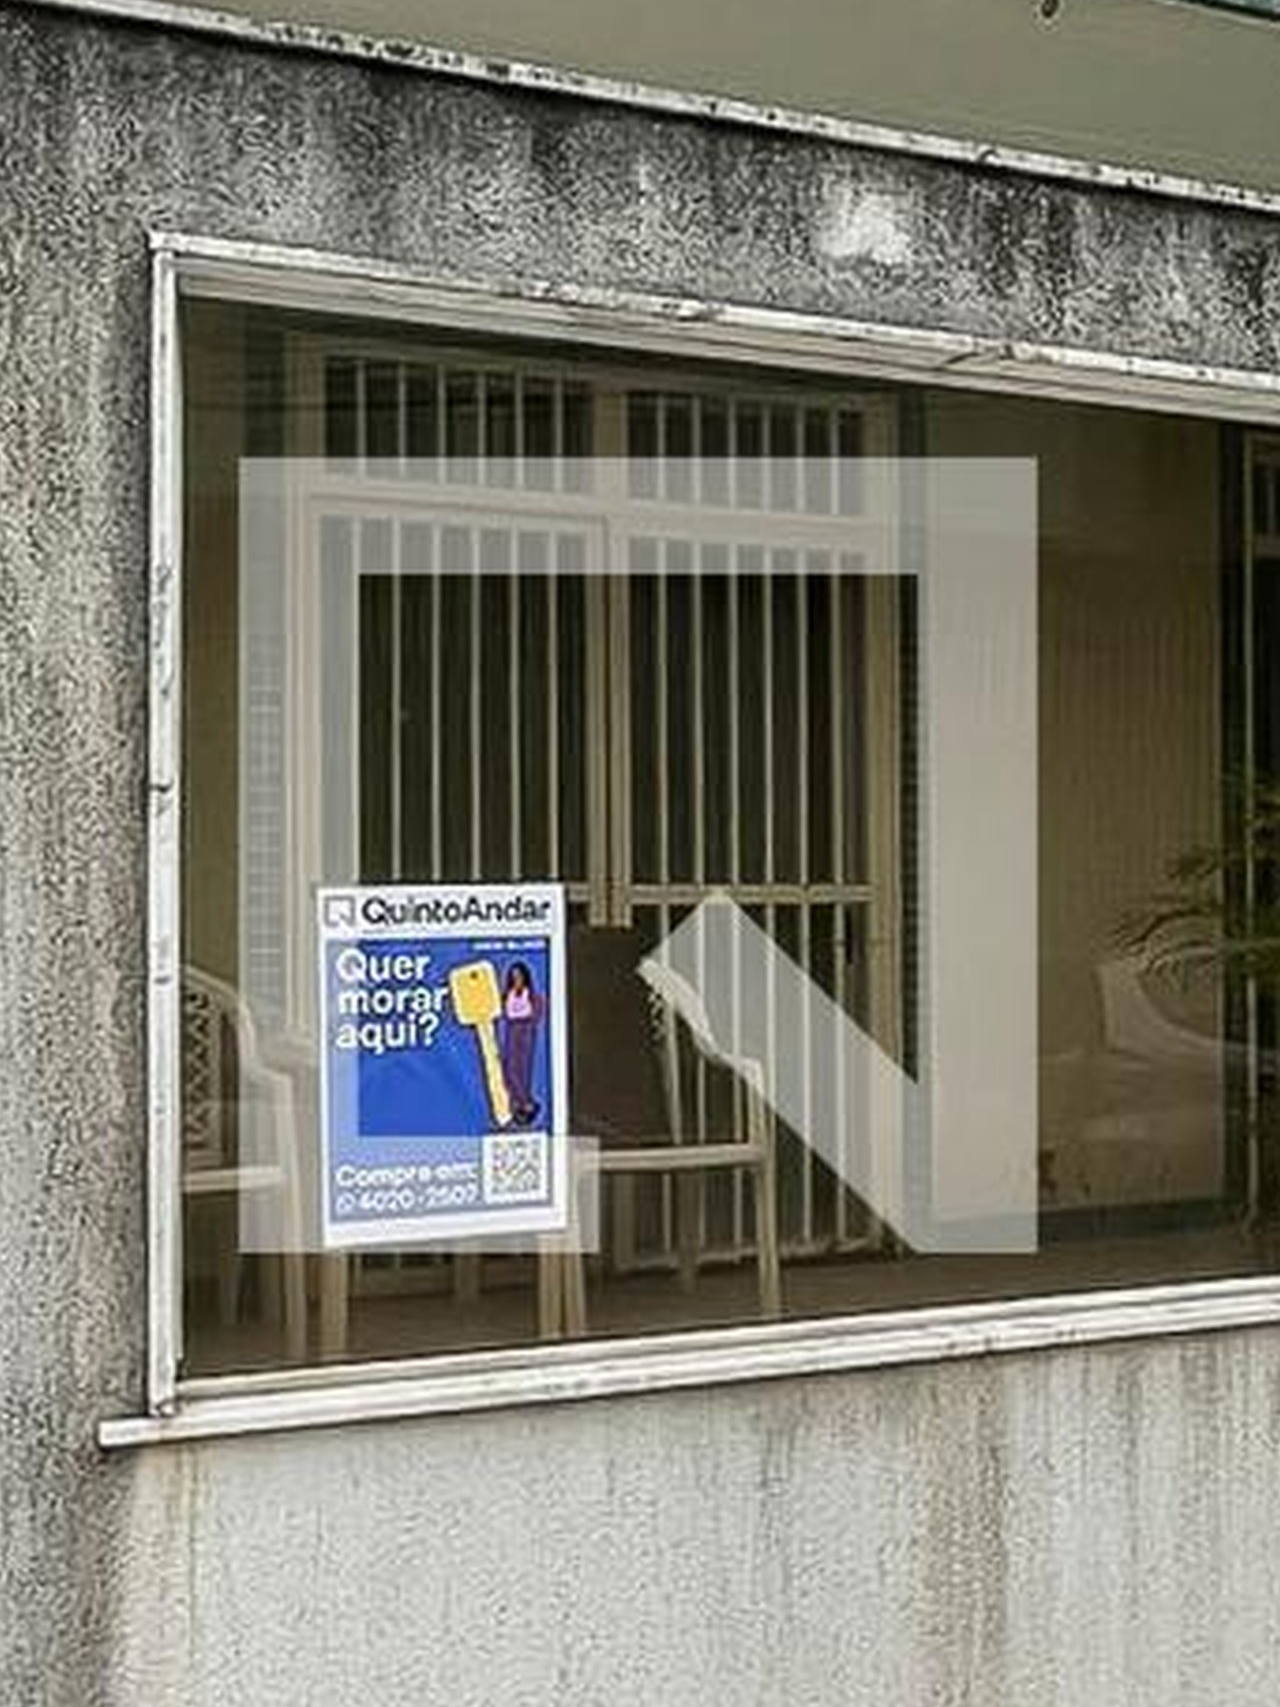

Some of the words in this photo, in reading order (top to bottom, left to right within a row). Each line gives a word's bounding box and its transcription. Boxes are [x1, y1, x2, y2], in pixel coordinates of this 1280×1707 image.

[361, 896, 551, 927] QuintoAndar
[336, 948, 431, 984] Quer
[339, 986, 449, 1014] morar
[335, 1013, 439, 1055] aqui?
